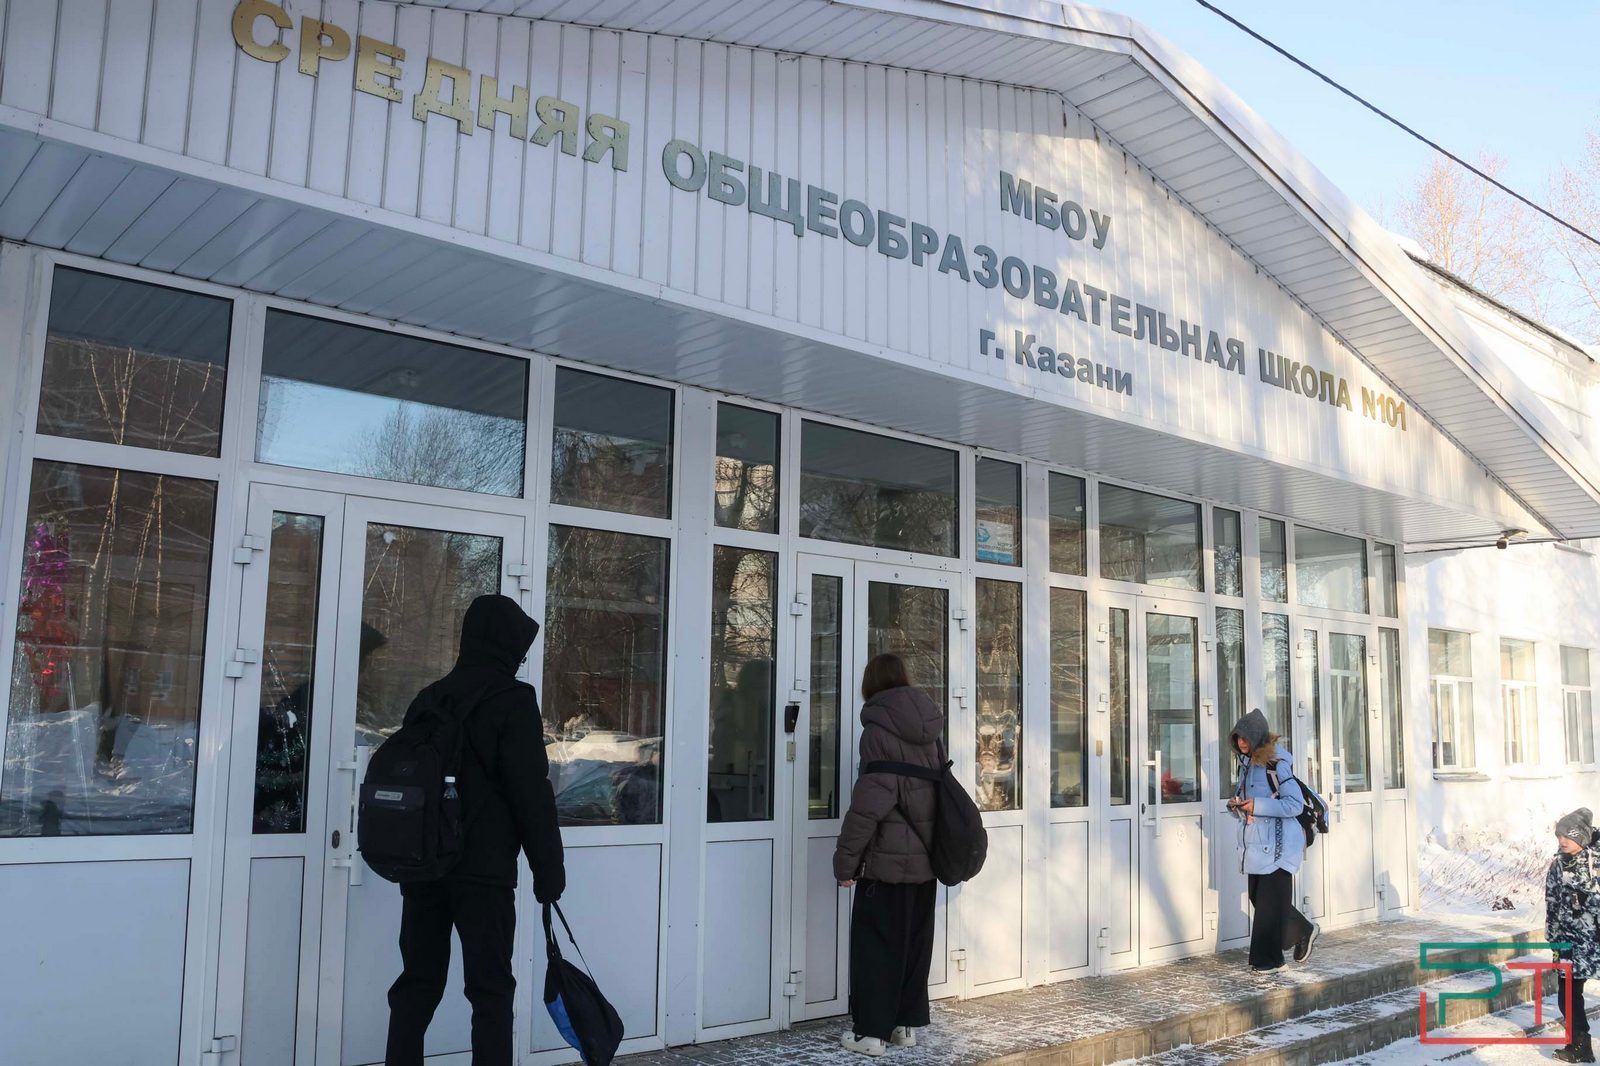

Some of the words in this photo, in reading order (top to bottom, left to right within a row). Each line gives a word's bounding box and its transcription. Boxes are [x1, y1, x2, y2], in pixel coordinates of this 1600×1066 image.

[231, 0, 631, 172] СРЕДНЯЯ
[662, 139, 1246, 375] ОБЩЕОБРАЗОВАТЕЛЬНАЯ
[1258, 347, 1353, 412] ШКОЛА
[1000, 170, 1111, 250] МБОУ
[979, 328, 1005, 361] г.
[1014, 330, 1134, 396] Казани
